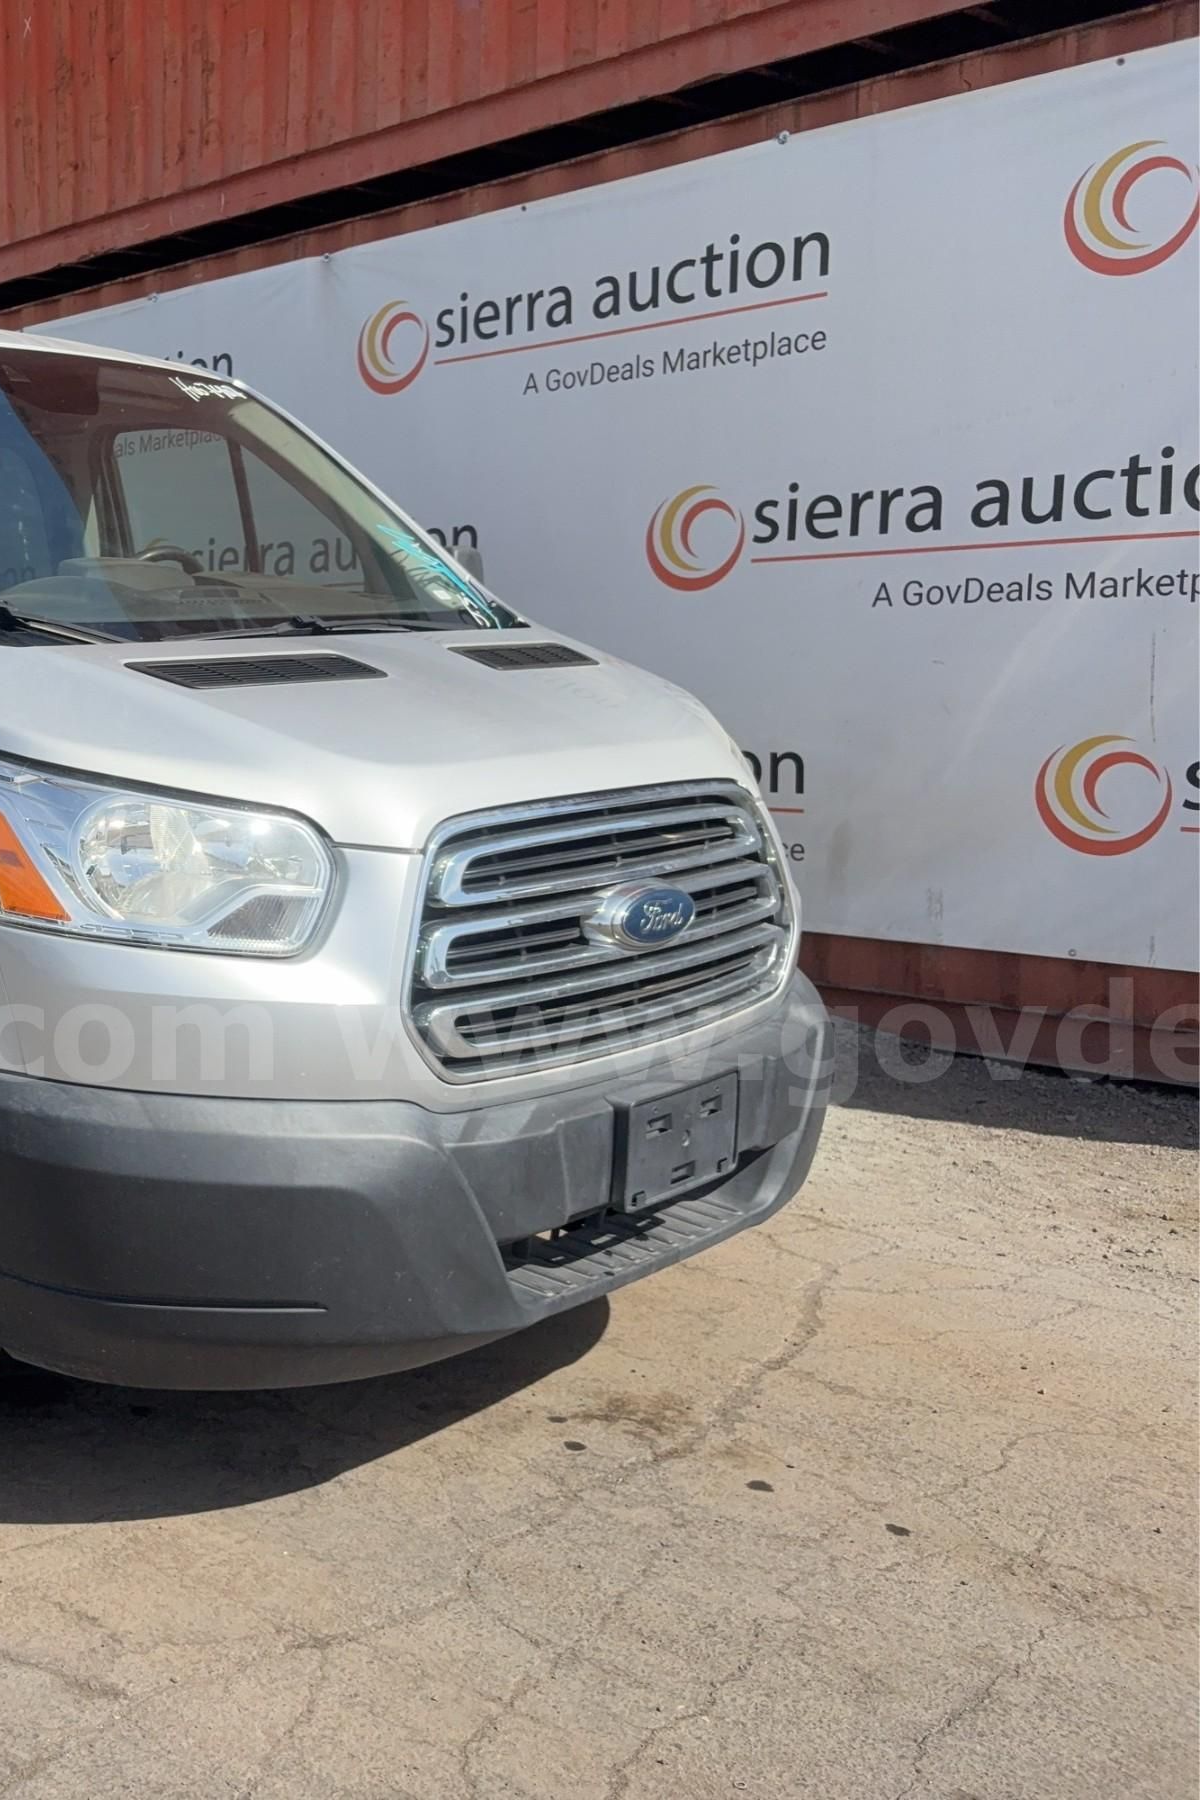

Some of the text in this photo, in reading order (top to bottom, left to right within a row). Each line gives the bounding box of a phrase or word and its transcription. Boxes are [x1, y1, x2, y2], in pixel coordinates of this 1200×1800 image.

[434, 231, 830, 349] sierra auction
[522, 330, 828, 396] A GovDeals Marketplace
[752, 446, 1200, 544] sierra aucti
[871, 581, 894, 608] A
[903, 573, 1053, 606] GovDeals
[639, 899, 685, 934] Ford
